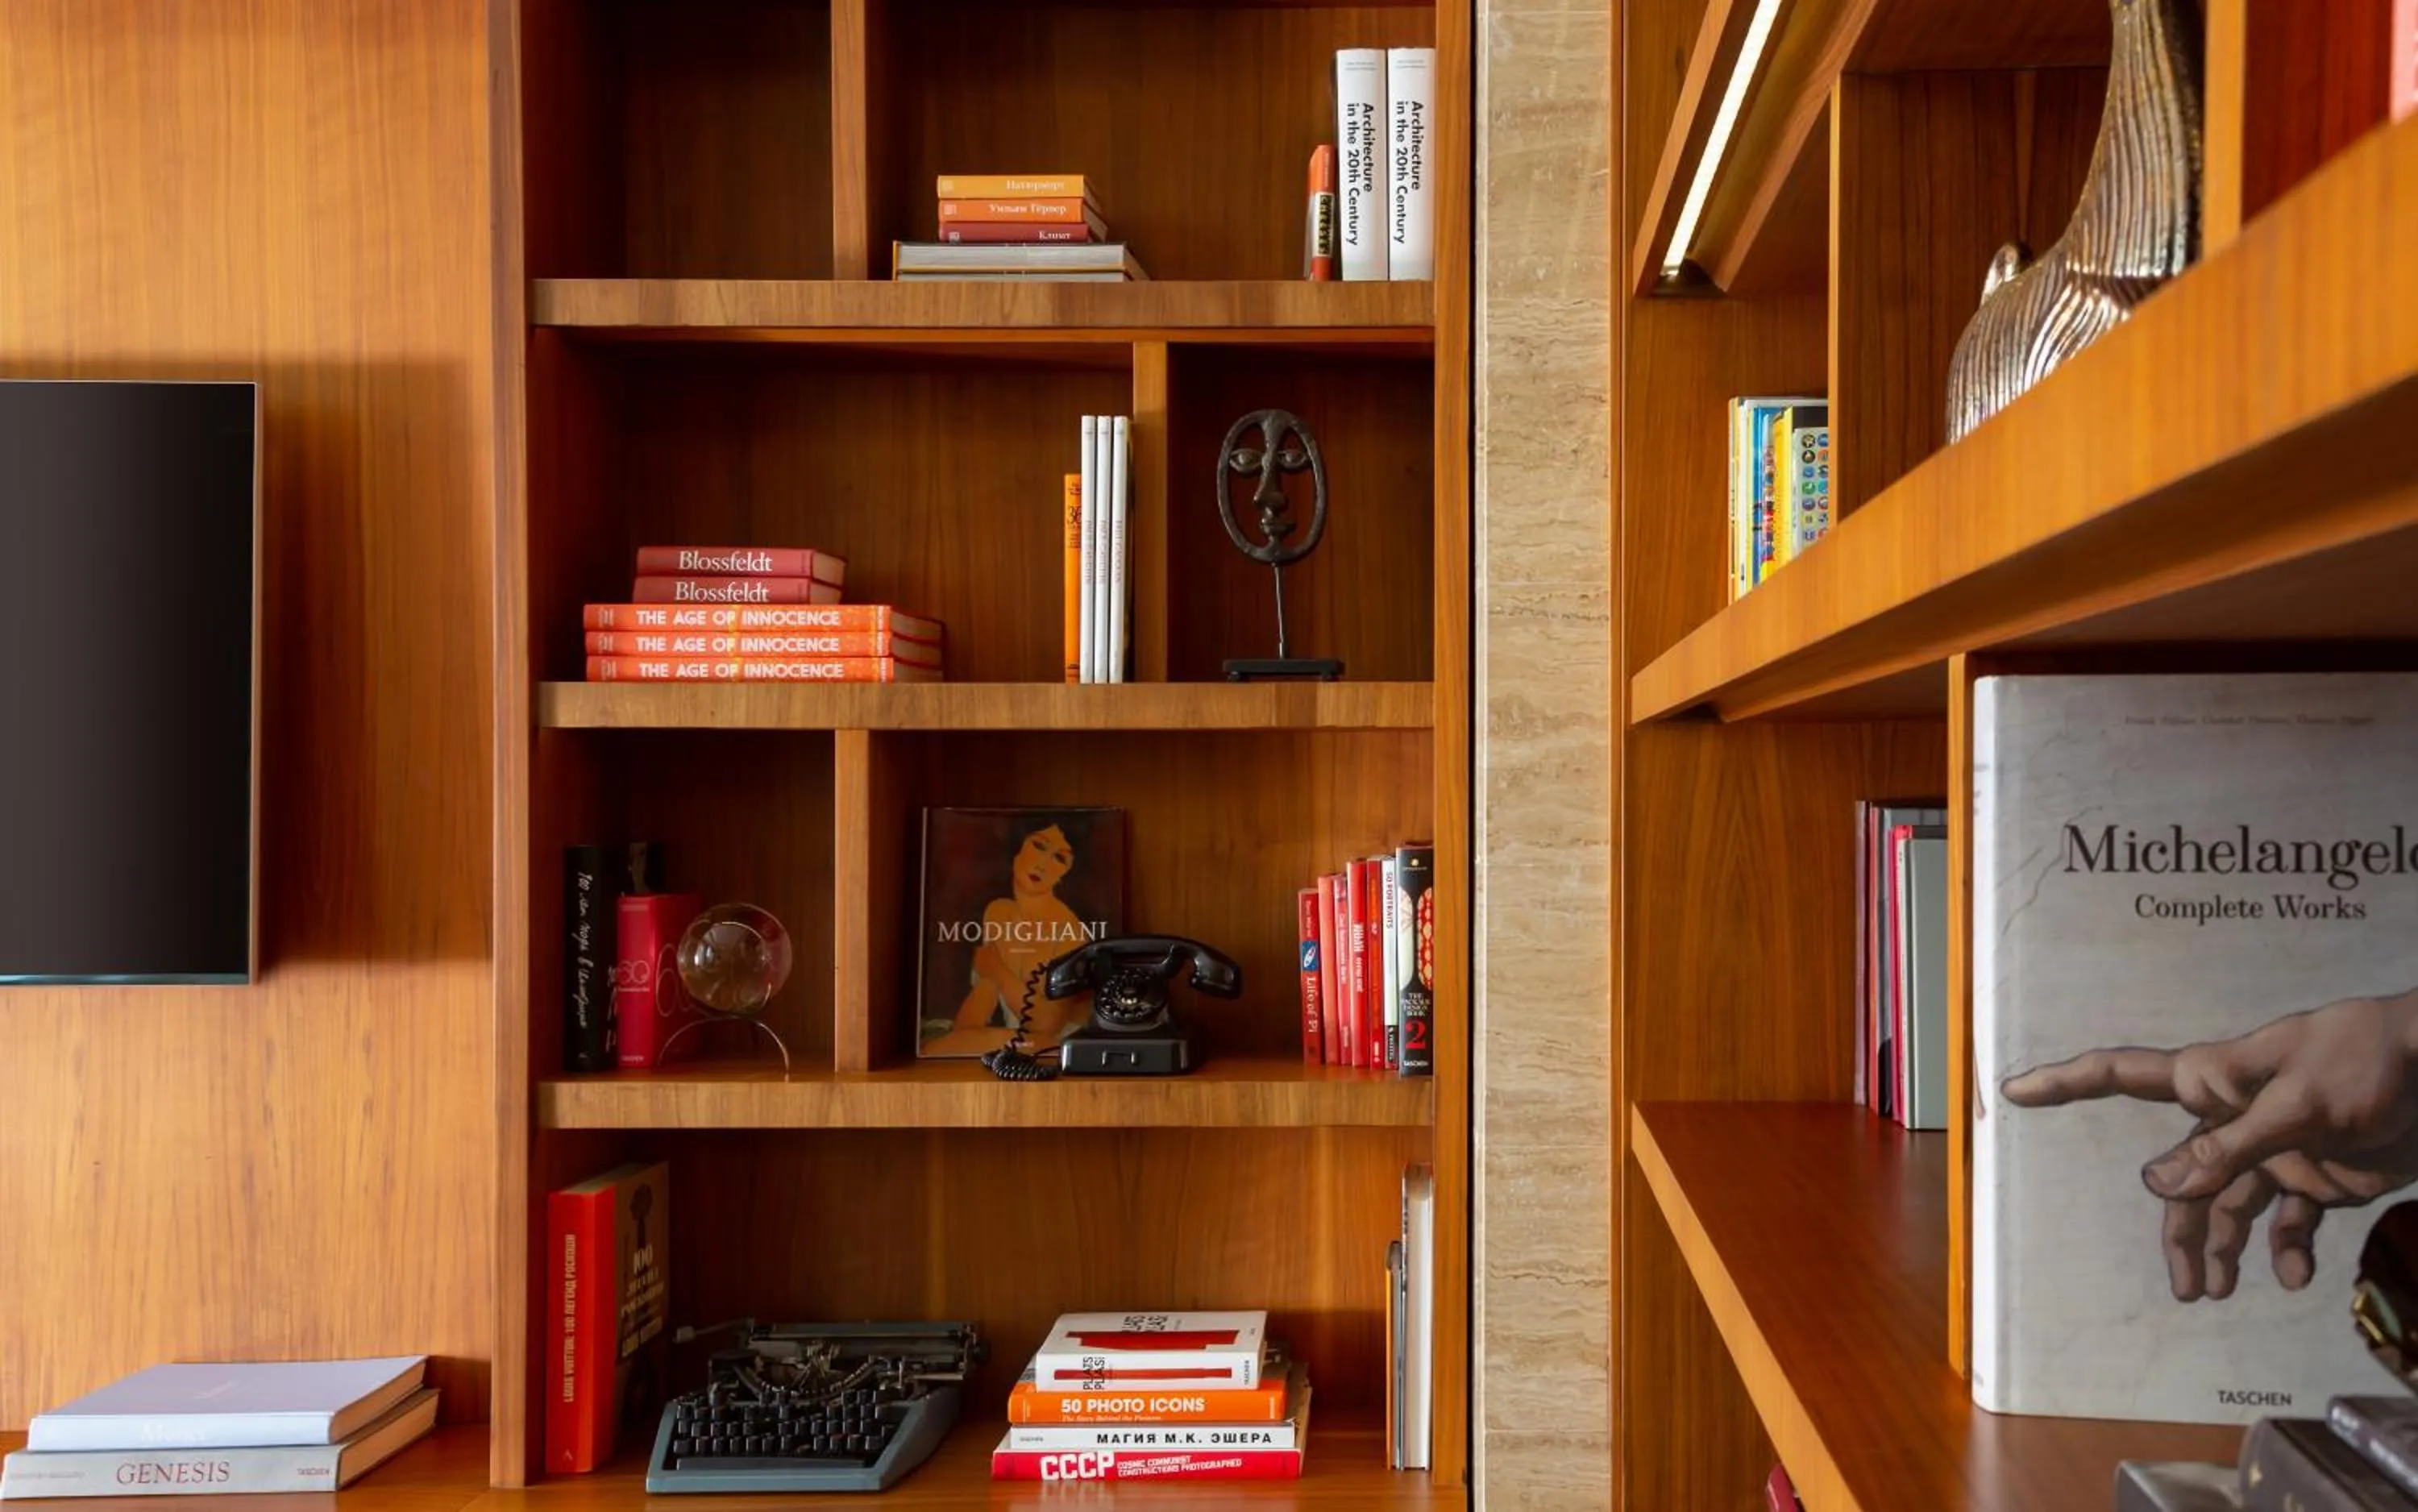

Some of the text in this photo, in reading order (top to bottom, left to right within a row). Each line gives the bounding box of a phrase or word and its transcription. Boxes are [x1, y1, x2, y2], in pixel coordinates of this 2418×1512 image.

[1362, 102, 1376, 193] Architecture
[1411, 101, 1423, 190] Architecture
[1345, 103, 1361, 245] in the 20th Century
[1394, 102, 1408, 244] in the 20th Century
[1039, 231, 1071, 240] Климт
[679, 550, 773, 571] Blossfeldt
[675, 581, 769, 602] Blossfeldt
[636, 610, 841, 626] THE AGE OF INNOCENCE
[636, 636, 840, 653] THE AGE OF INNOCENCE
[639, 663, 844, 679] THE AGE OF INNOCENCE
[2134, 893, 2367, 926] Complete Works
[937, 921, 1108, 942] MODIGLIANI
[1306, 976, 1318, 1032] Life of Pi
[1405, 1019, 1427, 1050] 2
[1062, 1397, 1206, 1413] 50 PHOTO ICONS
[2217, 1389, 2292, 1406] TASCHEN
[1097, 1432, 1272, 1444] МАГИЯ М.К. ЭШЕРА
[116, 1460, 231, 1485] GENESIS
[1040, 1450, 1116, 1481] CCCP
[1117, 1455, 1192, 1469] COSMIC COMMUNIST
[1181, 1458, 1242, 1473] PHOTOGRAPHED
